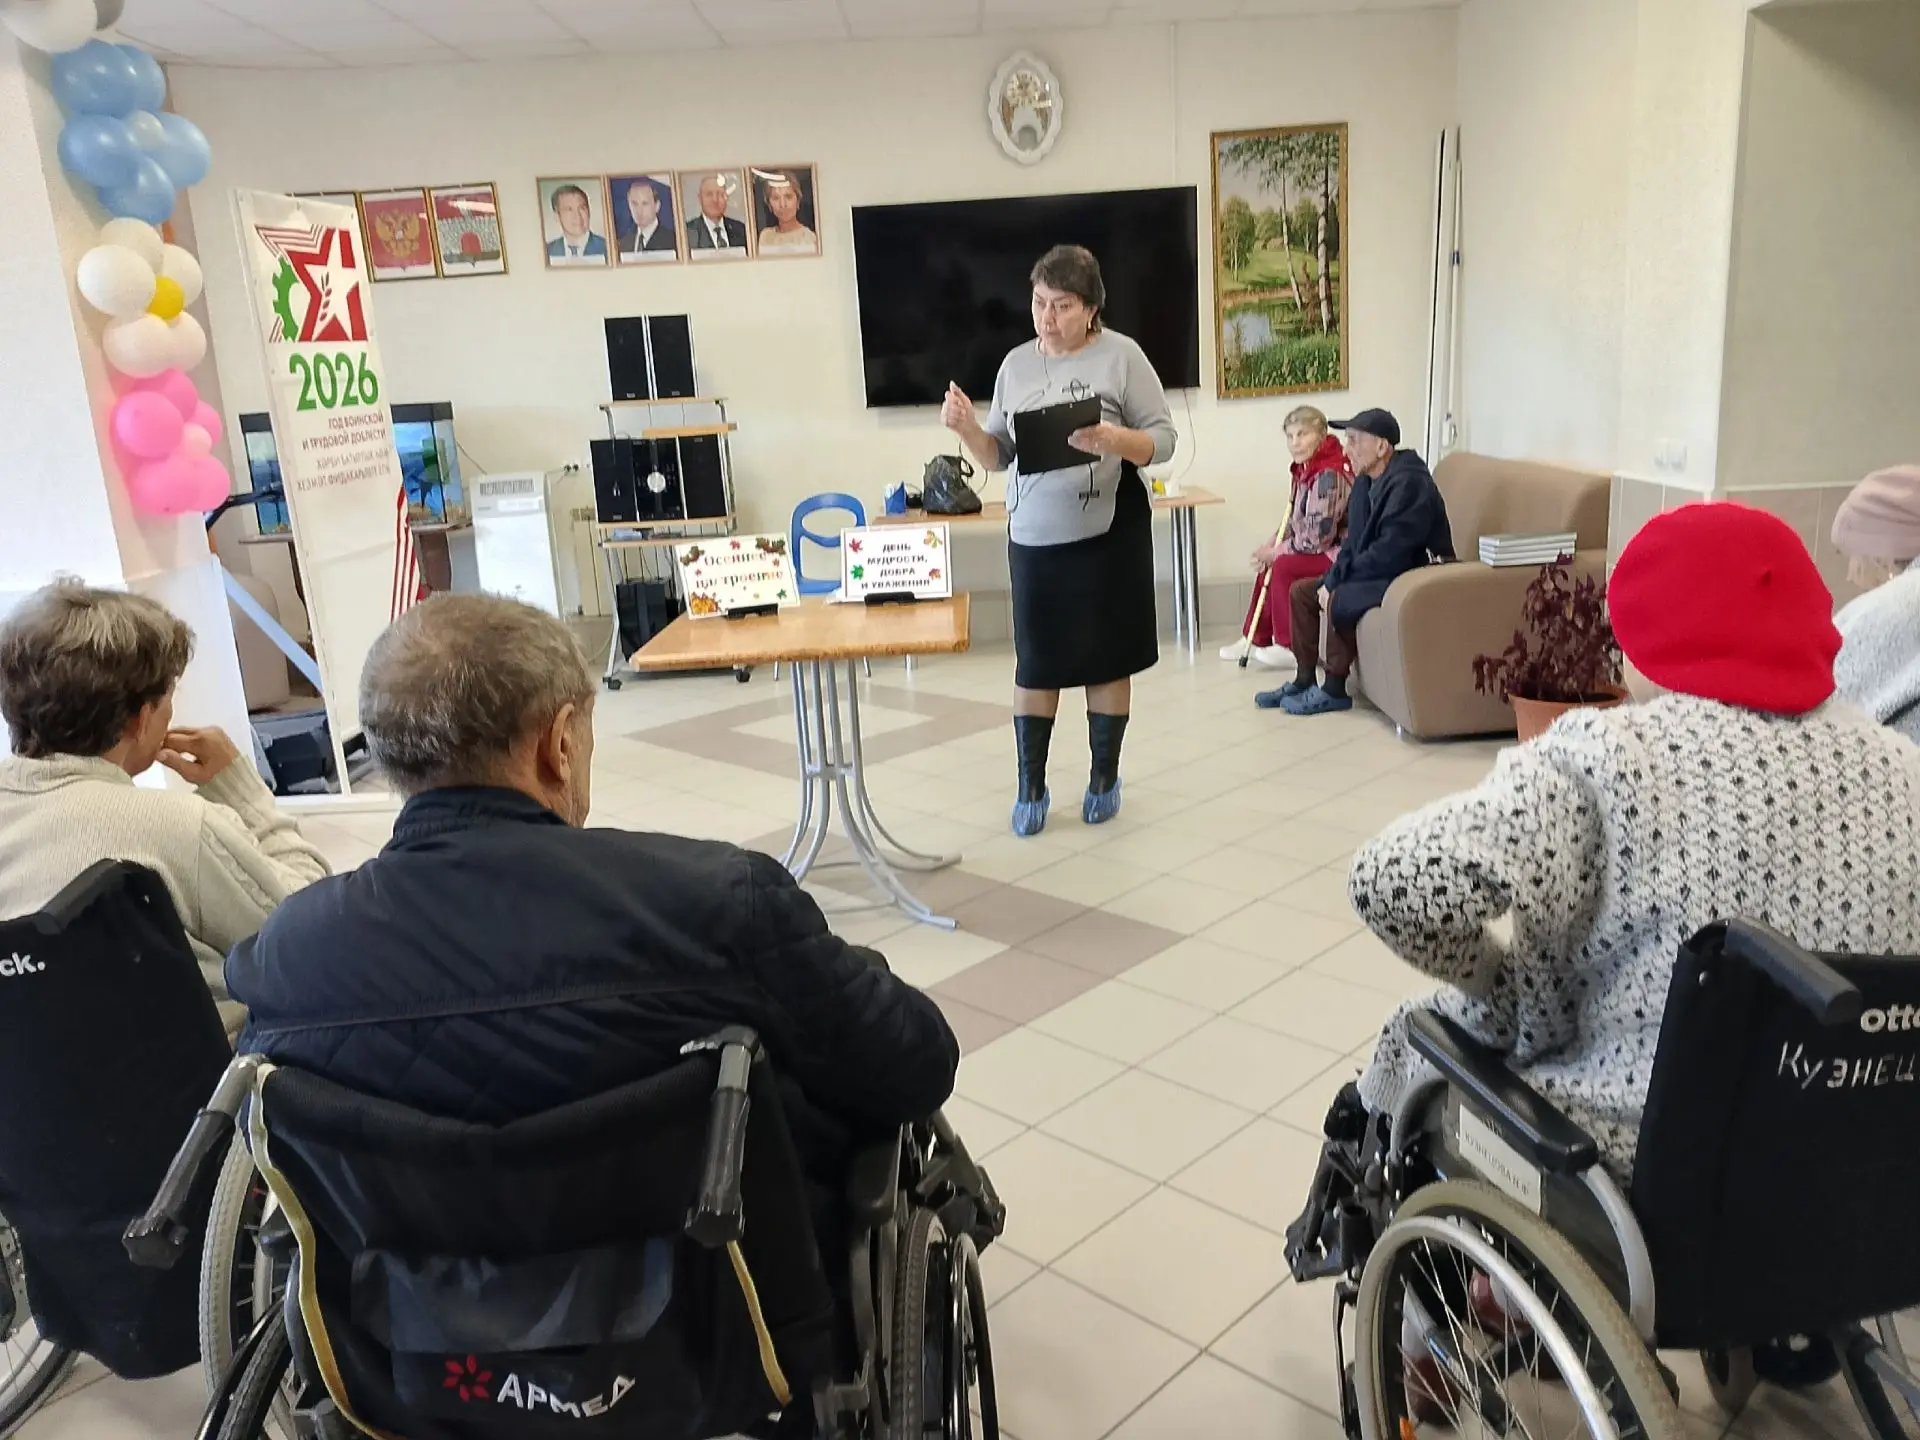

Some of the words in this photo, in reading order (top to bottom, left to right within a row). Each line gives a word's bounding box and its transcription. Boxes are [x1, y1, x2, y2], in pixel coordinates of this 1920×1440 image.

[289, 351, 379, 412] 2026
[882, 543, 911, 553] ДЕНЬ
[867, 554, 928, 565] МУДРОСТИ,
[880, 567, 915, 577] ДОБРА
[861, 582, 868, 590] И
